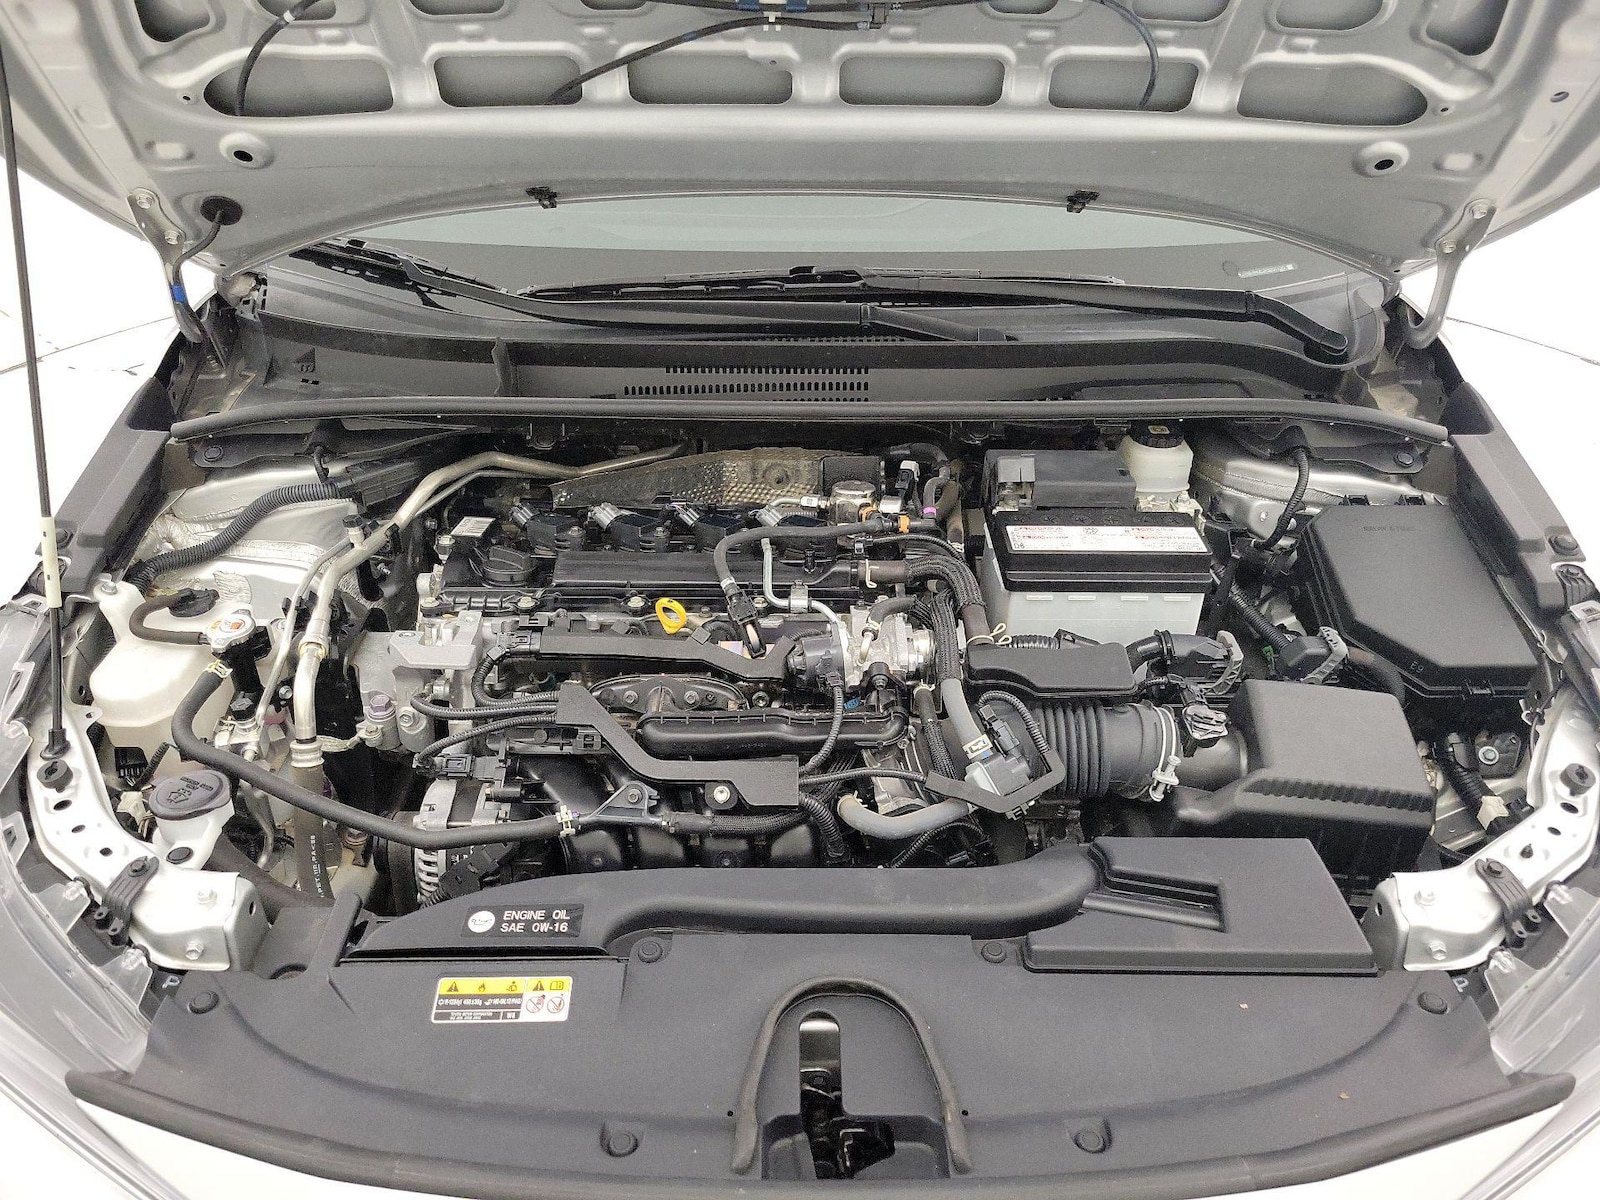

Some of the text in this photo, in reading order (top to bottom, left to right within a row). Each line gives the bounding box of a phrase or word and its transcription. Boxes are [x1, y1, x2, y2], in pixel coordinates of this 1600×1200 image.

[503, 909, 571, 921] ENGINE OIL
[500, 921, 569, 933] SAE 0W-16
